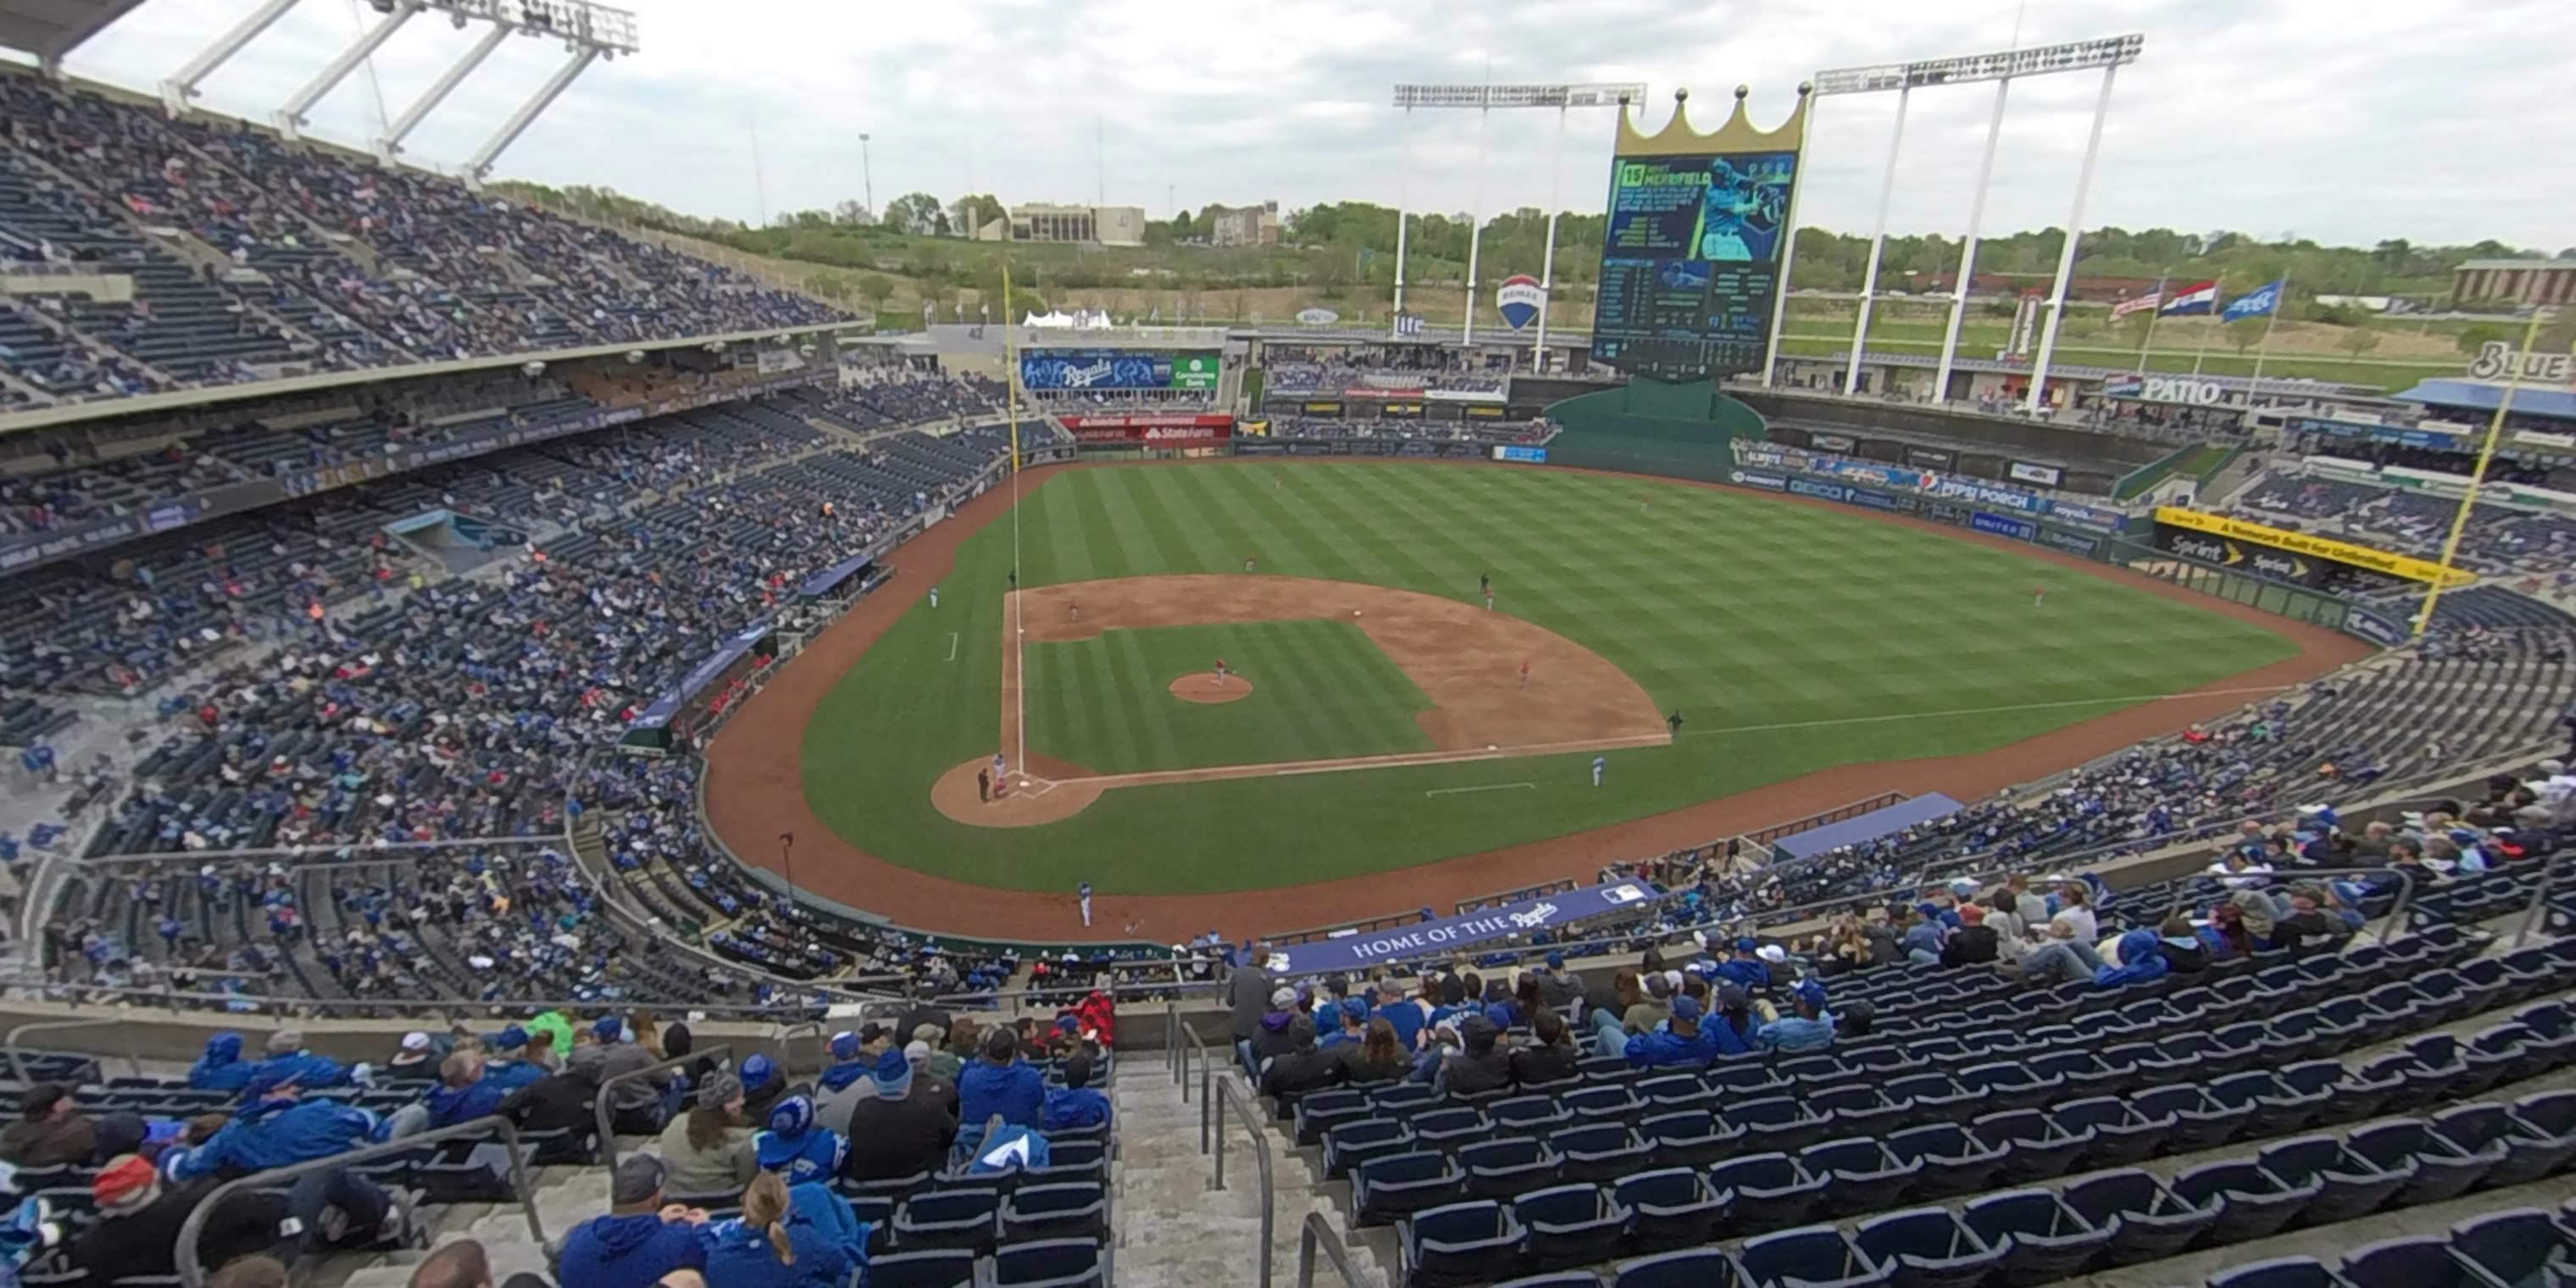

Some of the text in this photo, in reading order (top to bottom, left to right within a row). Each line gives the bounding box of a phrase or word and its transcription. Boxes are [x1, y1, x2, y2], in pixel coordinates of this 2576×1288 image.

[1626, 169, 1642, 183] 15
[1063, 358, 1112, 386] Royals
[2140, 378, 2221, 404] PATIO
[1789, 480, 1842, 500] GEICO
[1979, 488, 2029, 509] PORCH
[2171, 536, 2222, 561] Sprint
[2282, 535, 2310, 550] Built
[2254, 554, 2291, 574] Sprint
[1352, 901, 1559, 958] HOME OF THE Royals
